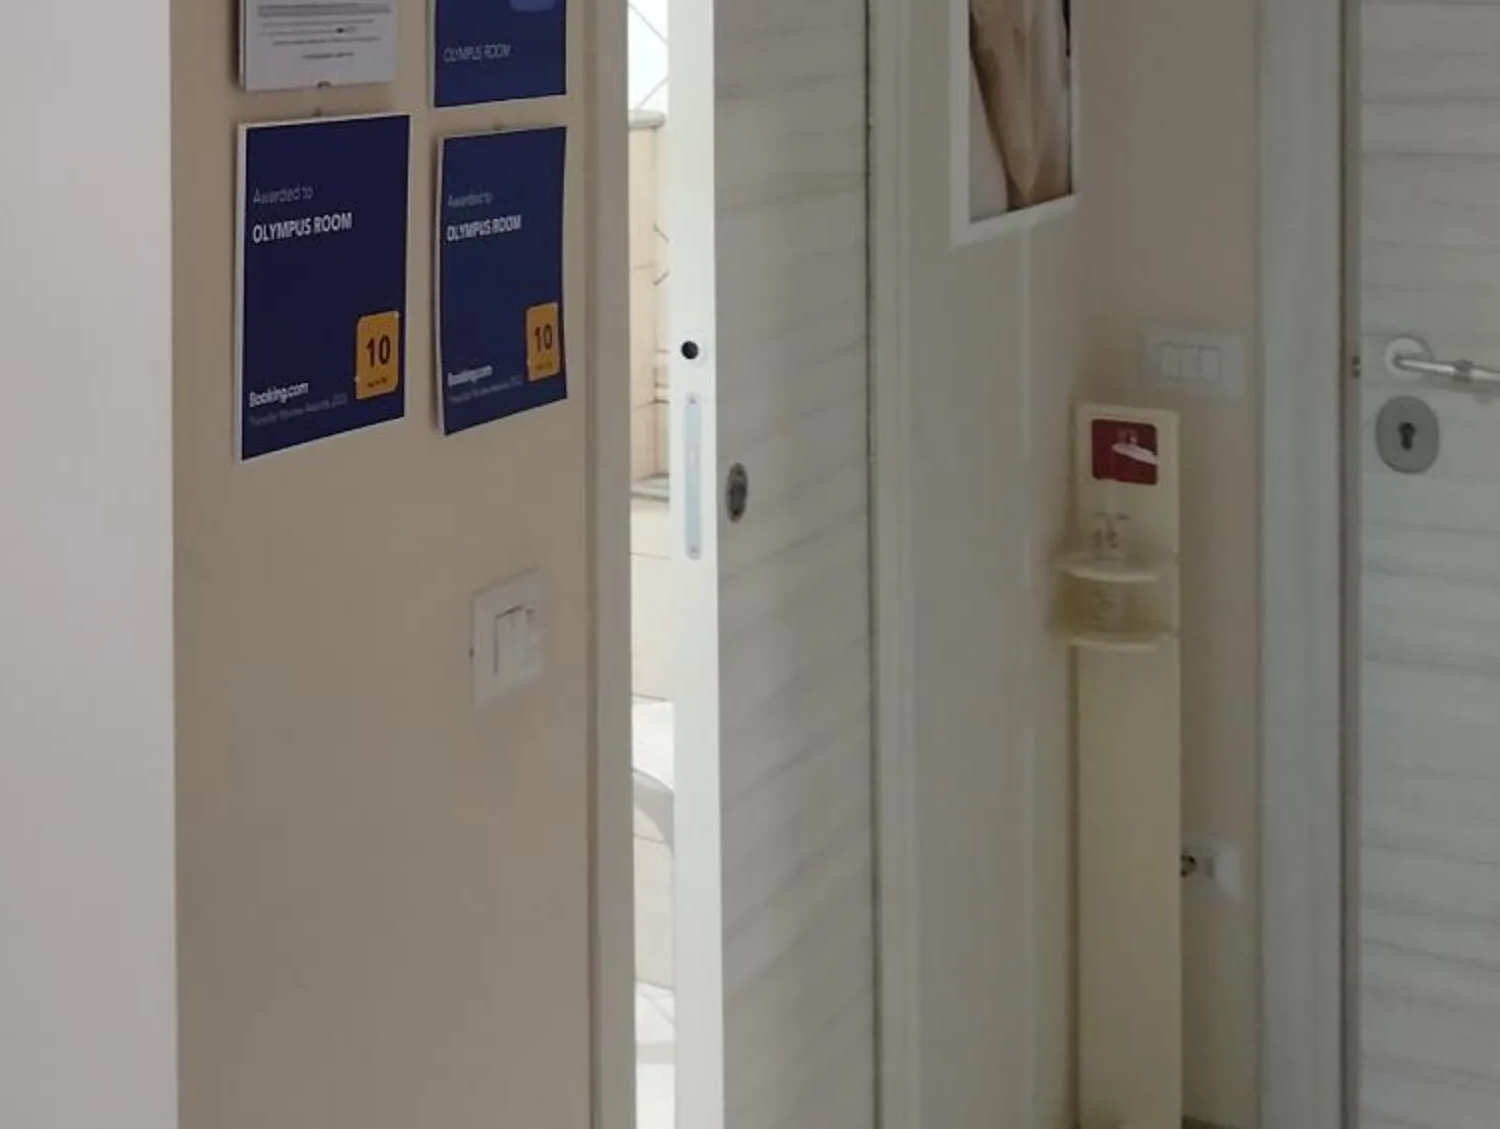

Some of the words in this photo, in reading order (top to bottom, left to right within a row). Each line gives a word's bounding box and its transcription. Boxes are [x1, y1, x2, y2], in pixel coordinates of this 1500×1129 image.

[252, 184, 301, 204] Awarded
[301, 185, 315, 201] to
[252, 217, 312, 244] OLYMPUS
[313, 211, 353, 235] ROOM
[446, 218, 492, 242] OLYMPUS
[492, 214, 522, 234] ROOM
[365, 334, 392, 369] 10
[534, 323, 553, 353] 10
[249, 382, 309, 408] Booking.com
